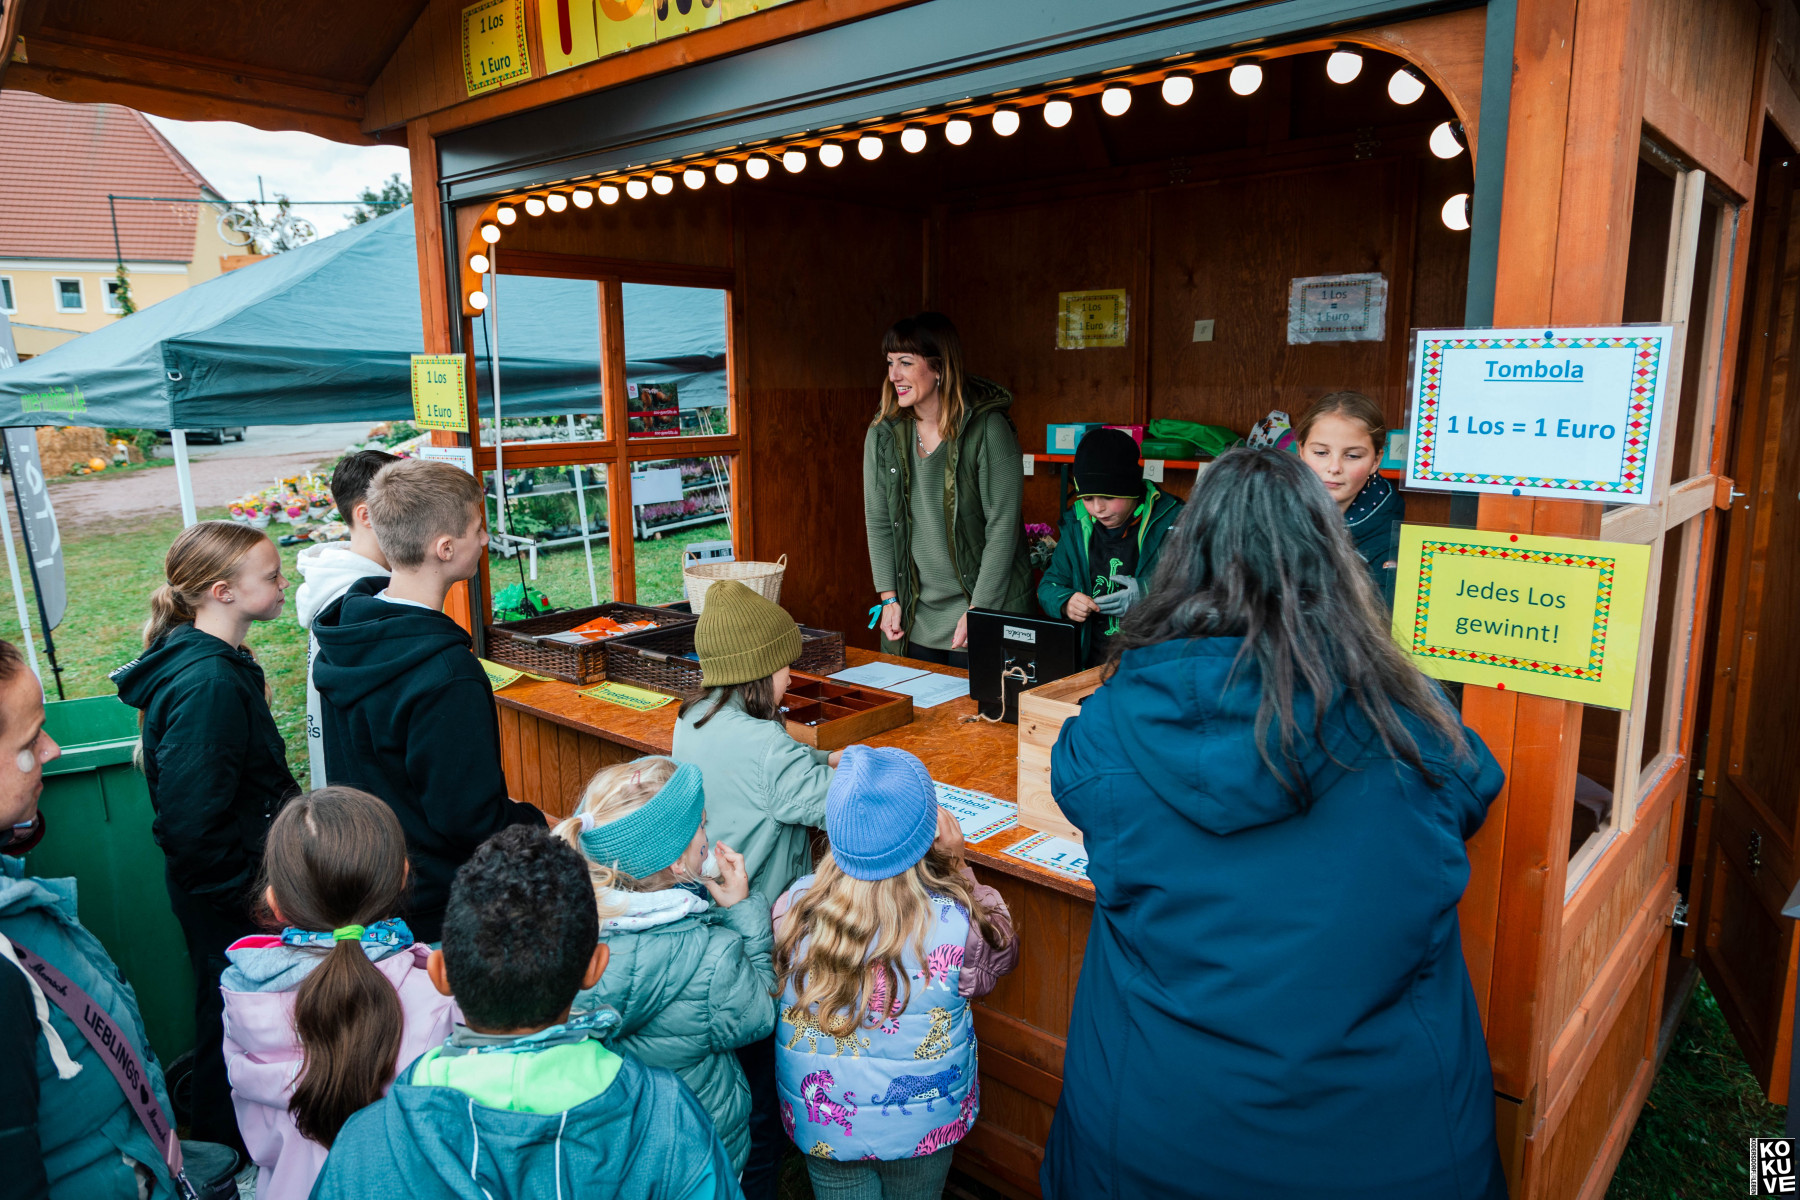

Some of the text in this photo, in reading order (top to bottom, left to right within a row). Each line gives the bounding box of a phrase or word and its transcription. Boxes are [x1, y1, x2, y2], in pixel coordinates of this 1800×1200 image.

[480, 14, 504, 34] 1 Los
[481, 55, 511, 77] 1 Euro
[1321, 289, 1347, 300] 1 Los
[1082, 303, 1102, 312] 1 Los
[1317, 311, 1350, 322] 1 Euro
[1079, 321, 1104, 331] 1 Euro
[427, 371, 447, 384] 1 Los
[1485, 359, 1584, 379] Tombola
[427, 404, 452, 418] 1 Euro
[1447, 415, 1459, 434] 1
[1467, 415, 1505, 436] Los
[1534, 418, 1547, 437] 1
[1556, 418, 1616, 440] Euro
[1456, 579, 1566, 609] Jedes Los
[1455, 616, 1560, 644] gewinnt!
[943, 793, 990, 810] Tombola
[959, 807, 978, 817] Los
[1050, 852, 1067, 862] 1
[29, 963, 67, 997] Mensch
[84, 1004, 140, 1091] LIEBLINGS
